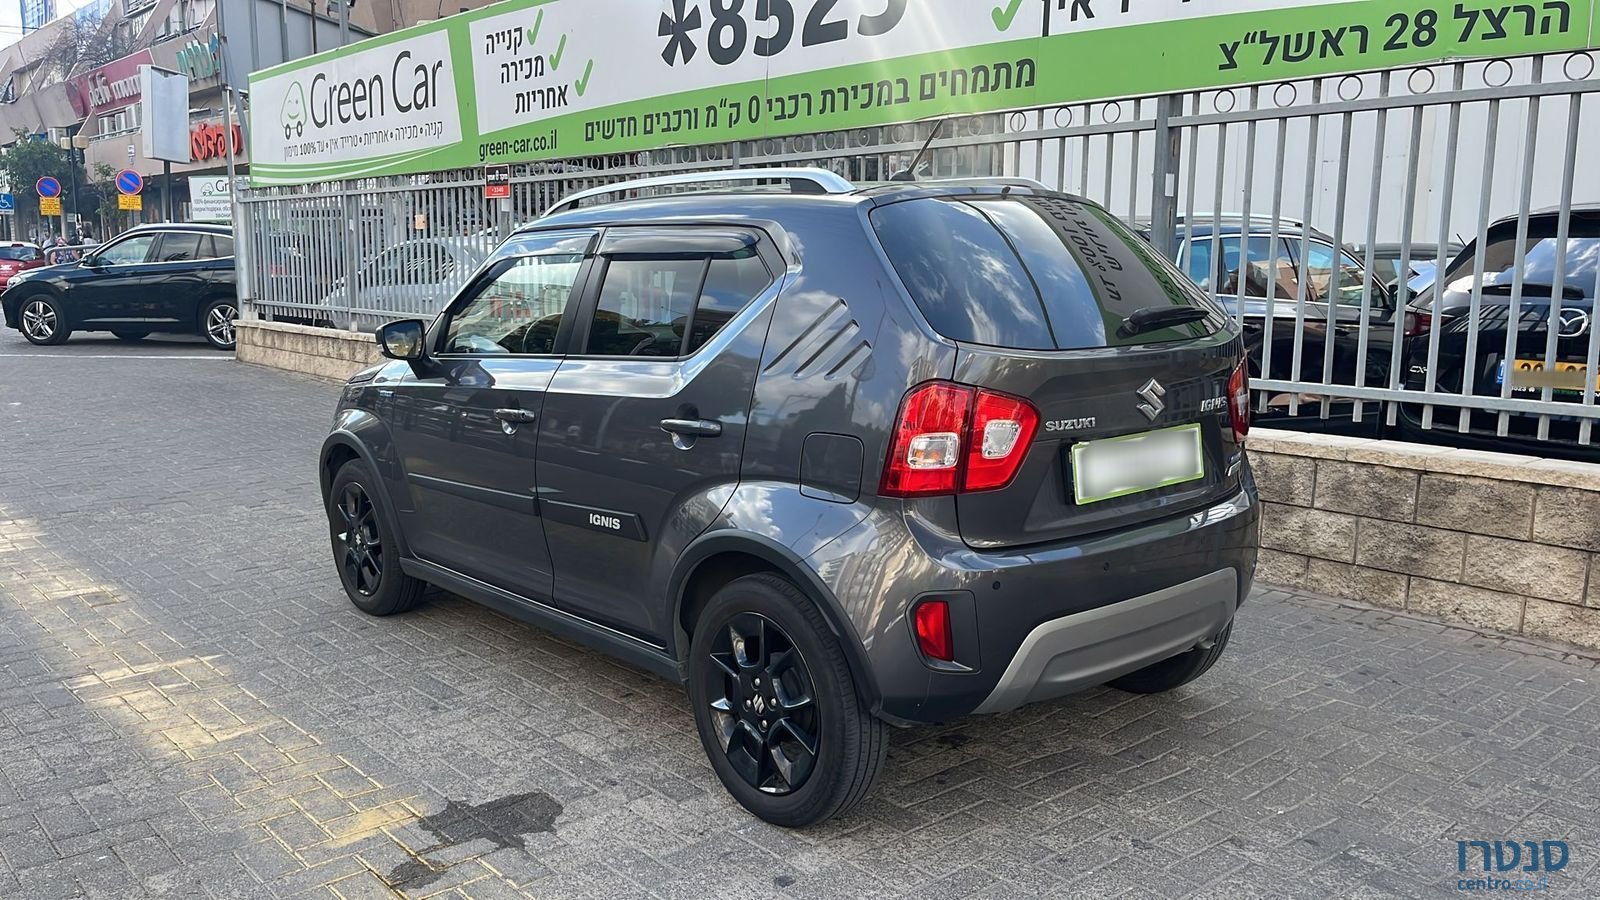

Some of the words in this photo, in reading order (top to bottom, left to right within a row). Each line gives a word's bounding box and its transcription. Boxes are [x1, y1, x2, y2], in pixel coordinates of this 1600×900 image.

[1383, 9, 1438, 51] 28
[1453, 1, 1571, 42] הרצל
[486, 26, 523, 55] קנייה
[501, 55, 544, 84] מכירה
[919, 58, 1036, 101] מתמחים
[310, 72, 384, 129] Green
[392, 50, 443, 113] Car
[515, 84, 568, 114] אחריות
[819, 77, 910, 115] במכירת
[643, 107, 699, 135] ורכבים
[748, 95, 760, 124] 0
[767, 92, 813, 121] רכבי
[363, 129, 389, 145] אחריות
[395, 125, 418, 141] מכירה
[425, 121, 443, 139] קניה
[585, 116, 637, 142] חדשים
[300, 141, 316, 155] 100%
[479, 129, 557, 161] green-car.co.il
[1200, 396, 1228, 412] IGNIS
[1045, 416, 1096, 432] SUZUKI
[589, 513, 621, 530] IGNIS
